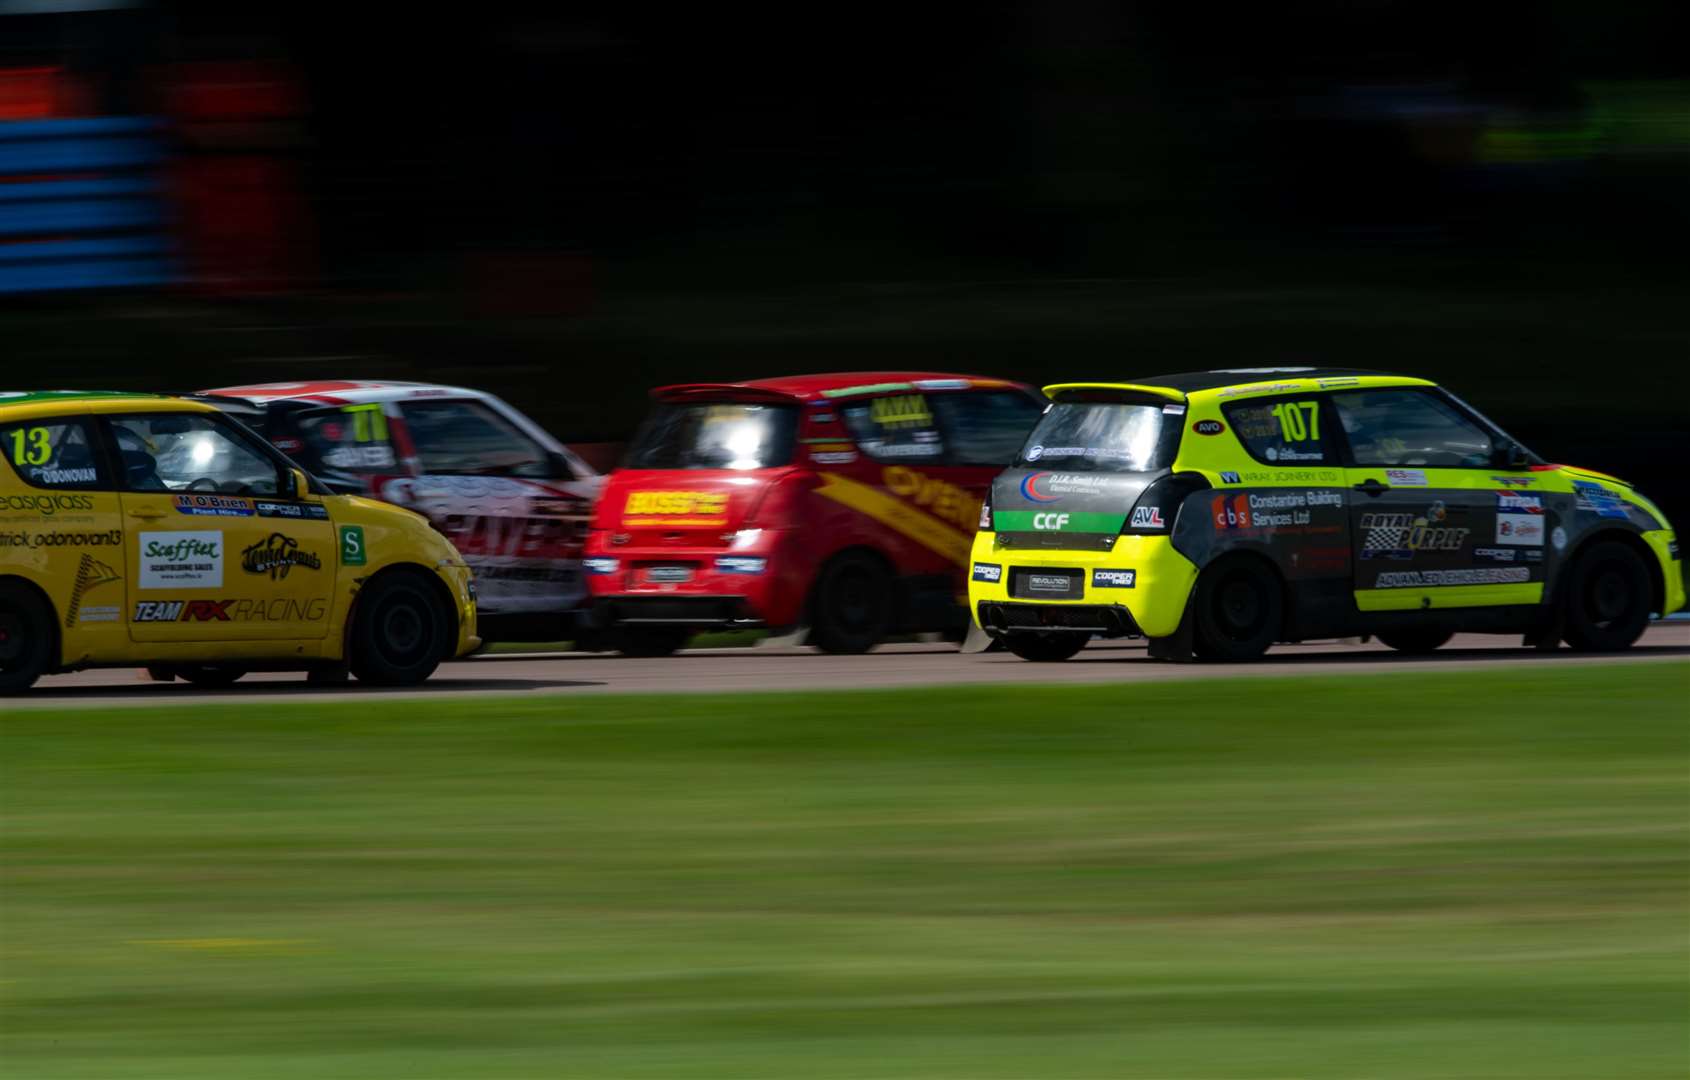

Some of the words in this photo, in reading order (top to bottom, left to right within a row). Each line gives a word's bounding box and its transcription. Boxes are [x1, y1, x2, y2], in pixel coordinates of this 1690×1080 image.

[1199, 422, 1221, 433] AVO
[1271, 401, 1320, 443] 107
[10, 427, 52, 466] 13
[1318, 472, 1338, 482] LTD
[178, 495, 192, 506] M
[196, 495, 248, 509] O'Brien
[1249, 493, 1305, 508] Constantine
[1306, 490, 1342, 508] Building
[257, 502, 301, 514] COOPER
[1131, 506, 1164, 527] AVL
[1033, 512, 1070, 530] CCF
[1251, 511, 1293, 526] Services
[1293, 508, 1311, 525] Ltd
[1360, 513, 1413, 529] ROYAL
[345, 531, 360, 555] S
[1396, 527, 1465, 551] PURPLE
[195, 563, 214, 571] SALES
[974, 565, 1001, 576] COOPER
[1031, 576, 1069, 585] REVOLUTION
[1095, 572, 1134, 581] COOPER
[133, 601, 183, 622] TEAM
[181, 600, 237, 621] RX
[234, 598, 326, 621] RACING
